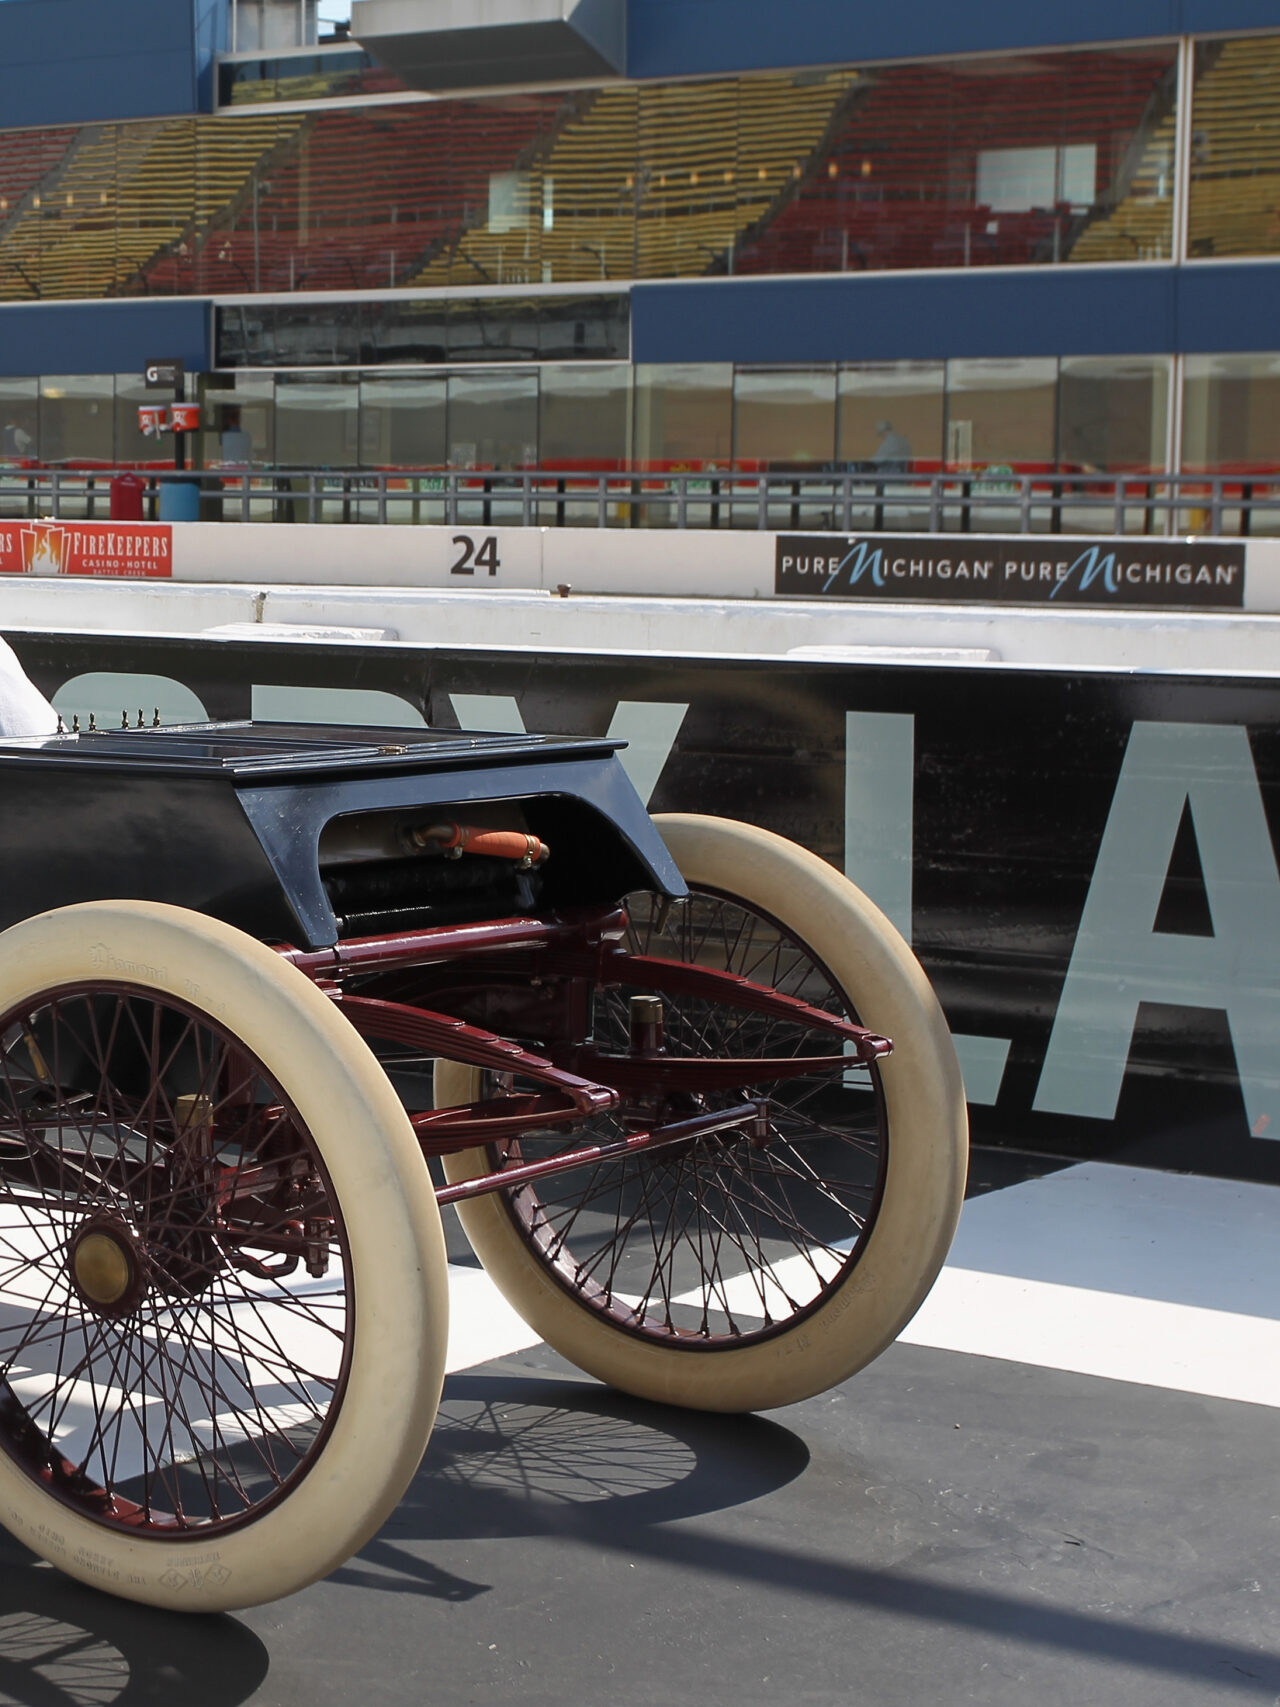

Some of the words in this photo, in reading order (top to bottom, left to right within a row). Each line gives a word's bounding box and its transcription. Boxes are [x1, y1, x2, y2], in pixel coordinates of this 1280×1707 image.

[73, 532, 168, 557] FIREKEEPERS
[82, 559, 119, 568] CASINO
[127, 561, 158, 570] HOTEL
[451, 534, 500, 576] 24
[782, 556, 839, 575] PURE
[822, 541, 989, 592] MICHIGAN
[1005, 562, 1068, 581] PURE
[1049, 545, 1233, 599] MICHIGAN
